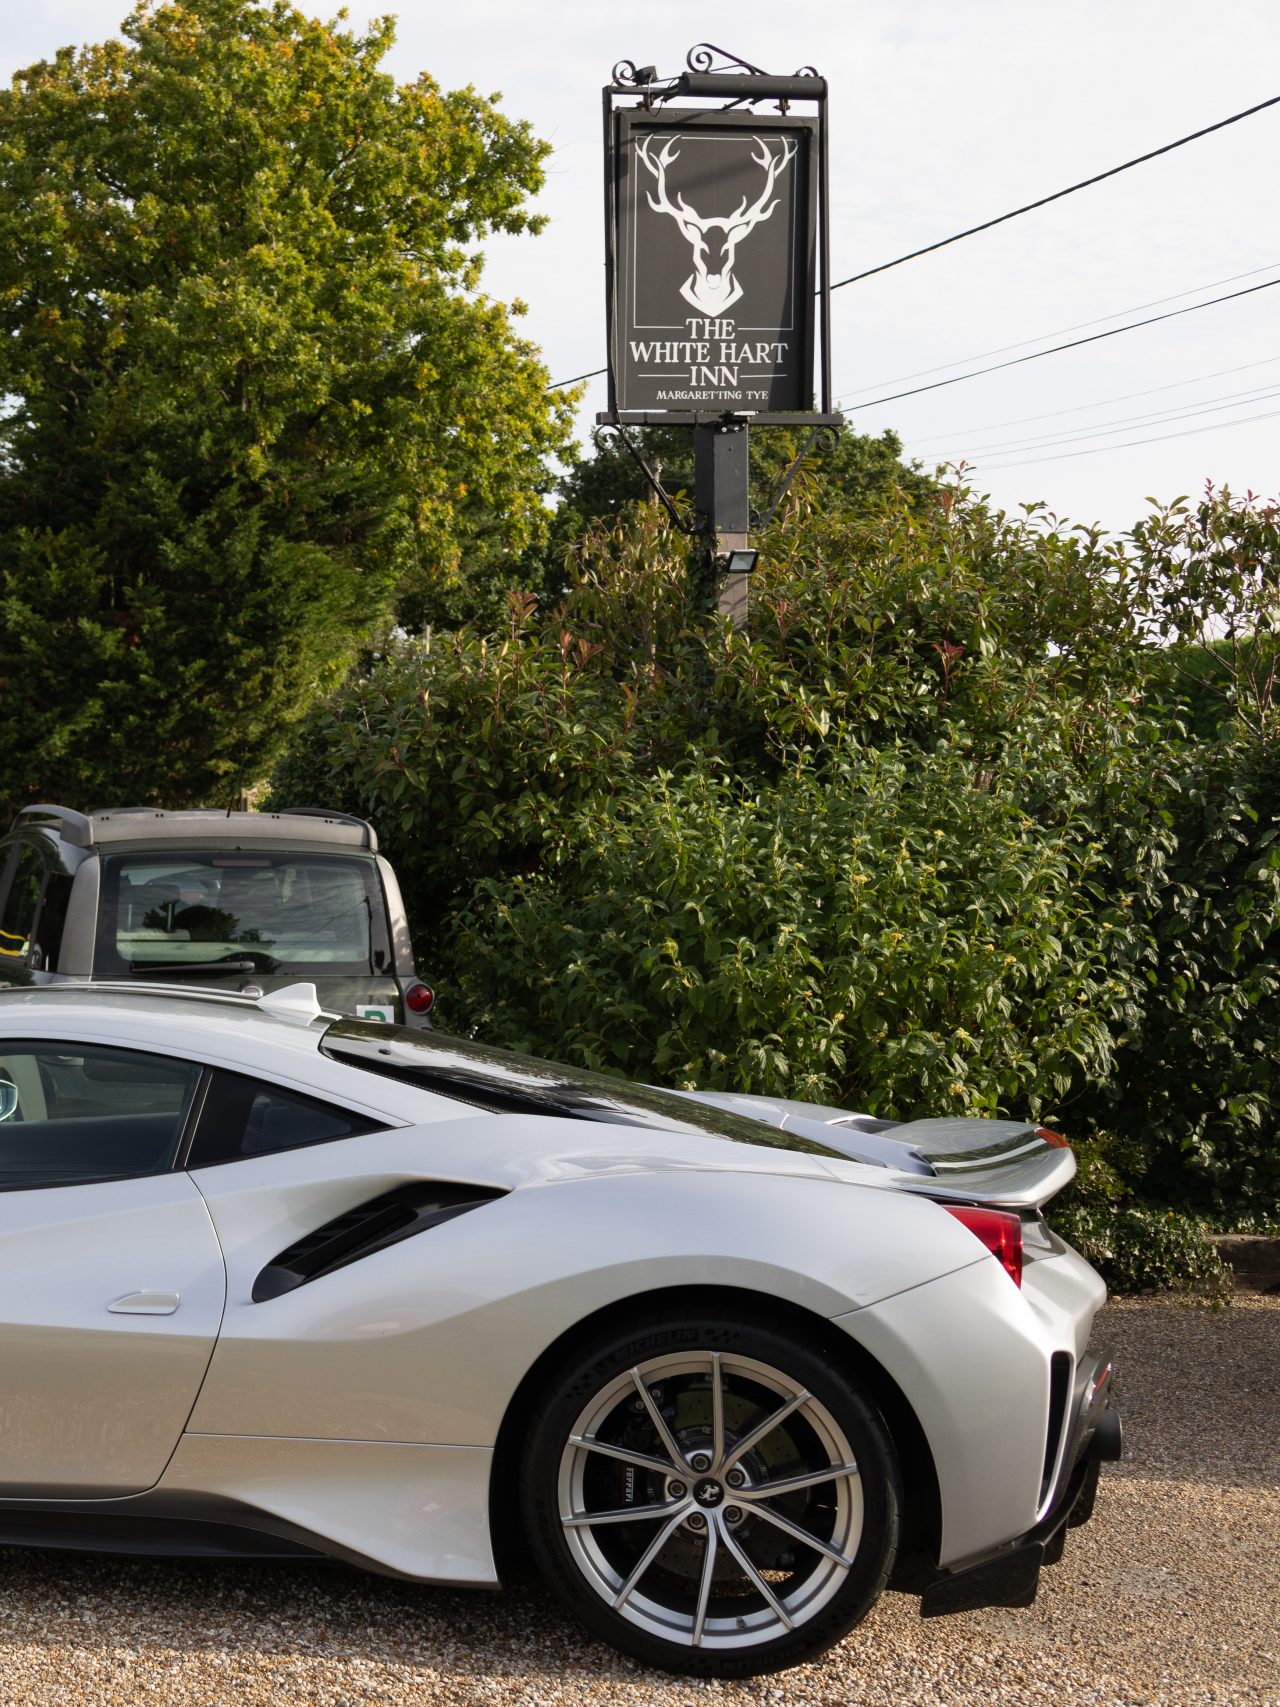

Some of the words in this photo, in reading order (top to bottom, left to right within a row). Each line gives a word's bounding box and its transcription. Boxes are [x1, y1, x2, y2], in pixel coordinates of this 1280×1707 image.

[686, 318, 736, 339] THE
[629, 341, 710, 363] WHITE
[720, 343, 789, 363] HART
[690, 366, 739, 386] INN
[656, 390, 742, 400] MARGARETTING
[746, 391, 768, 400] TYE
[614, 1329, 698, 1359] MICHELIN
[625, 1467, 634, 1502] Ferrari
